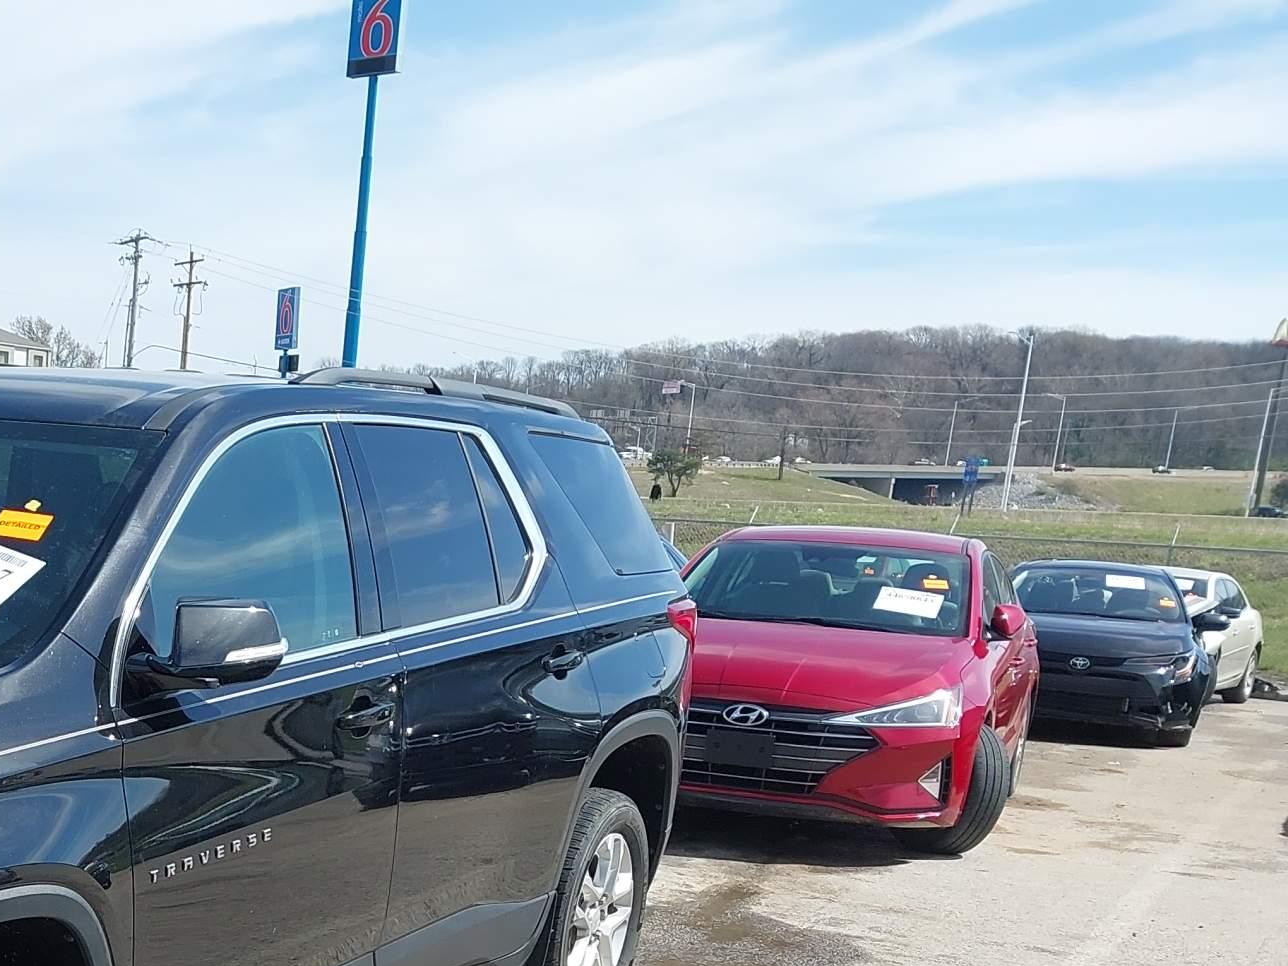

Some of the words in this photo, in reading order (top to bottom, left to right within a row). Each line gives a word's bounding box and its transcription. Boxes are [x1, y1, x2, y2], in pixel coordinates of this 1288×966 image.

[360, 0, 394, 58] 6
[279, 294, 293, 336] 6
[149, 827, 273, 884] TRAVERSE
